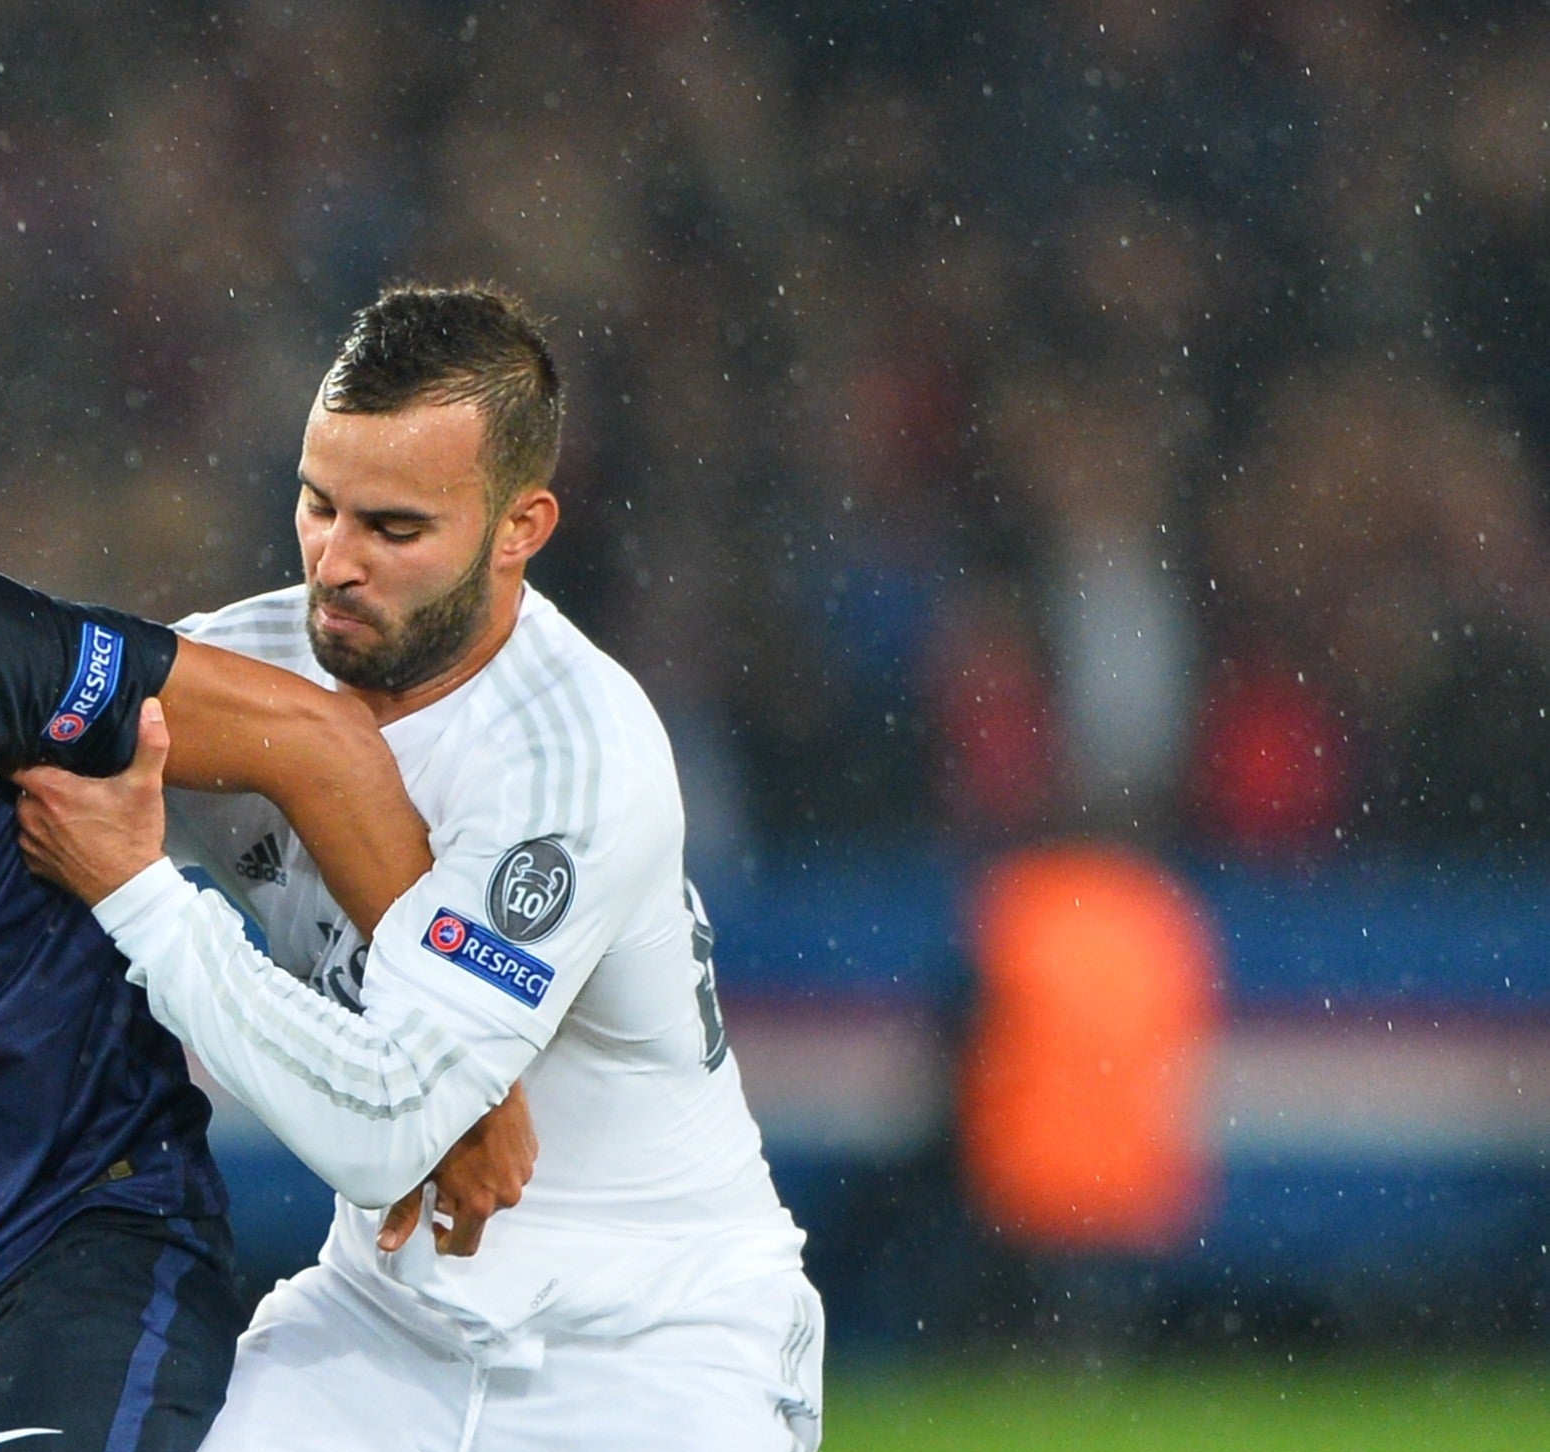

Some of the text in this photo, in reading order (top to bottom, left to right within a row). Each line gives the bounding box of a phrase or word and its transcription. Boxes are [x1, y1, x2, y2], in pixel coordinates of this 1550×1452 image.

[71, 625, 114, 715] RESPECT
[507, 886, 544, 920] 10
[461, 937, 551, 998] RESPECT
